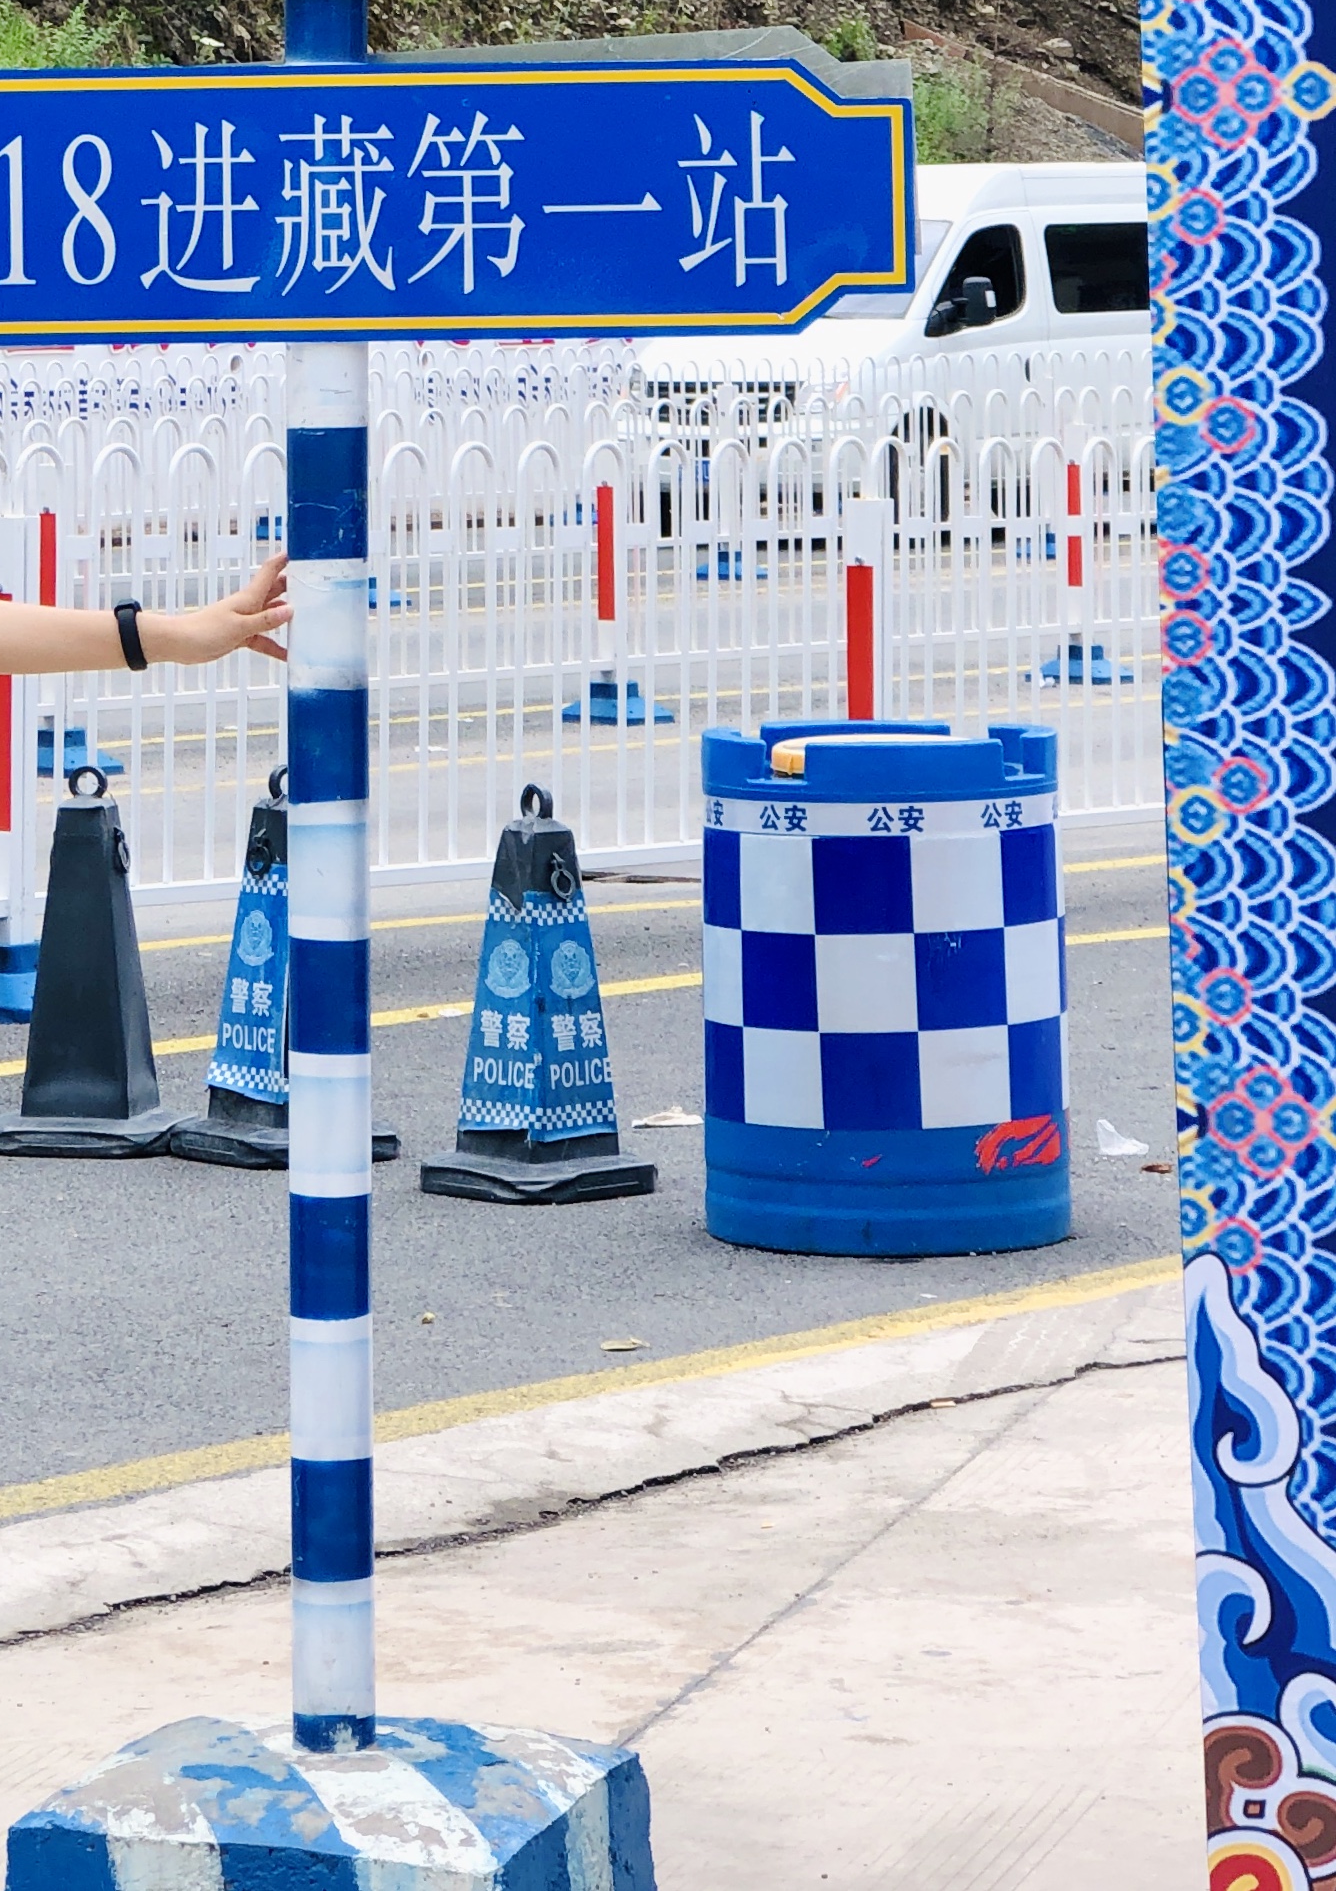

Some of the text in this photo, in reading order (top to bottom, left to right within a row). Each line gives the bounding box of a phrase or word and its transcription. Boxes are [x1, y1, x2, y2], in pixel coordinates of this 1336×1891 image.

[759, 804, 808, 832] 公安
[866, 806, 925, 834] 公安
[980, 800, 1023, 829] 公安
[230, 977, 272, 1018] 警察
[222, 1022, 276, 1054] POLICE
[480, 1009, 531, 1051] 警察
[551, 1010, 603, 1052] 警察
[473, 1056, 535, 1089] POLICE
[550, 1057, 613, 1090] POLICE
